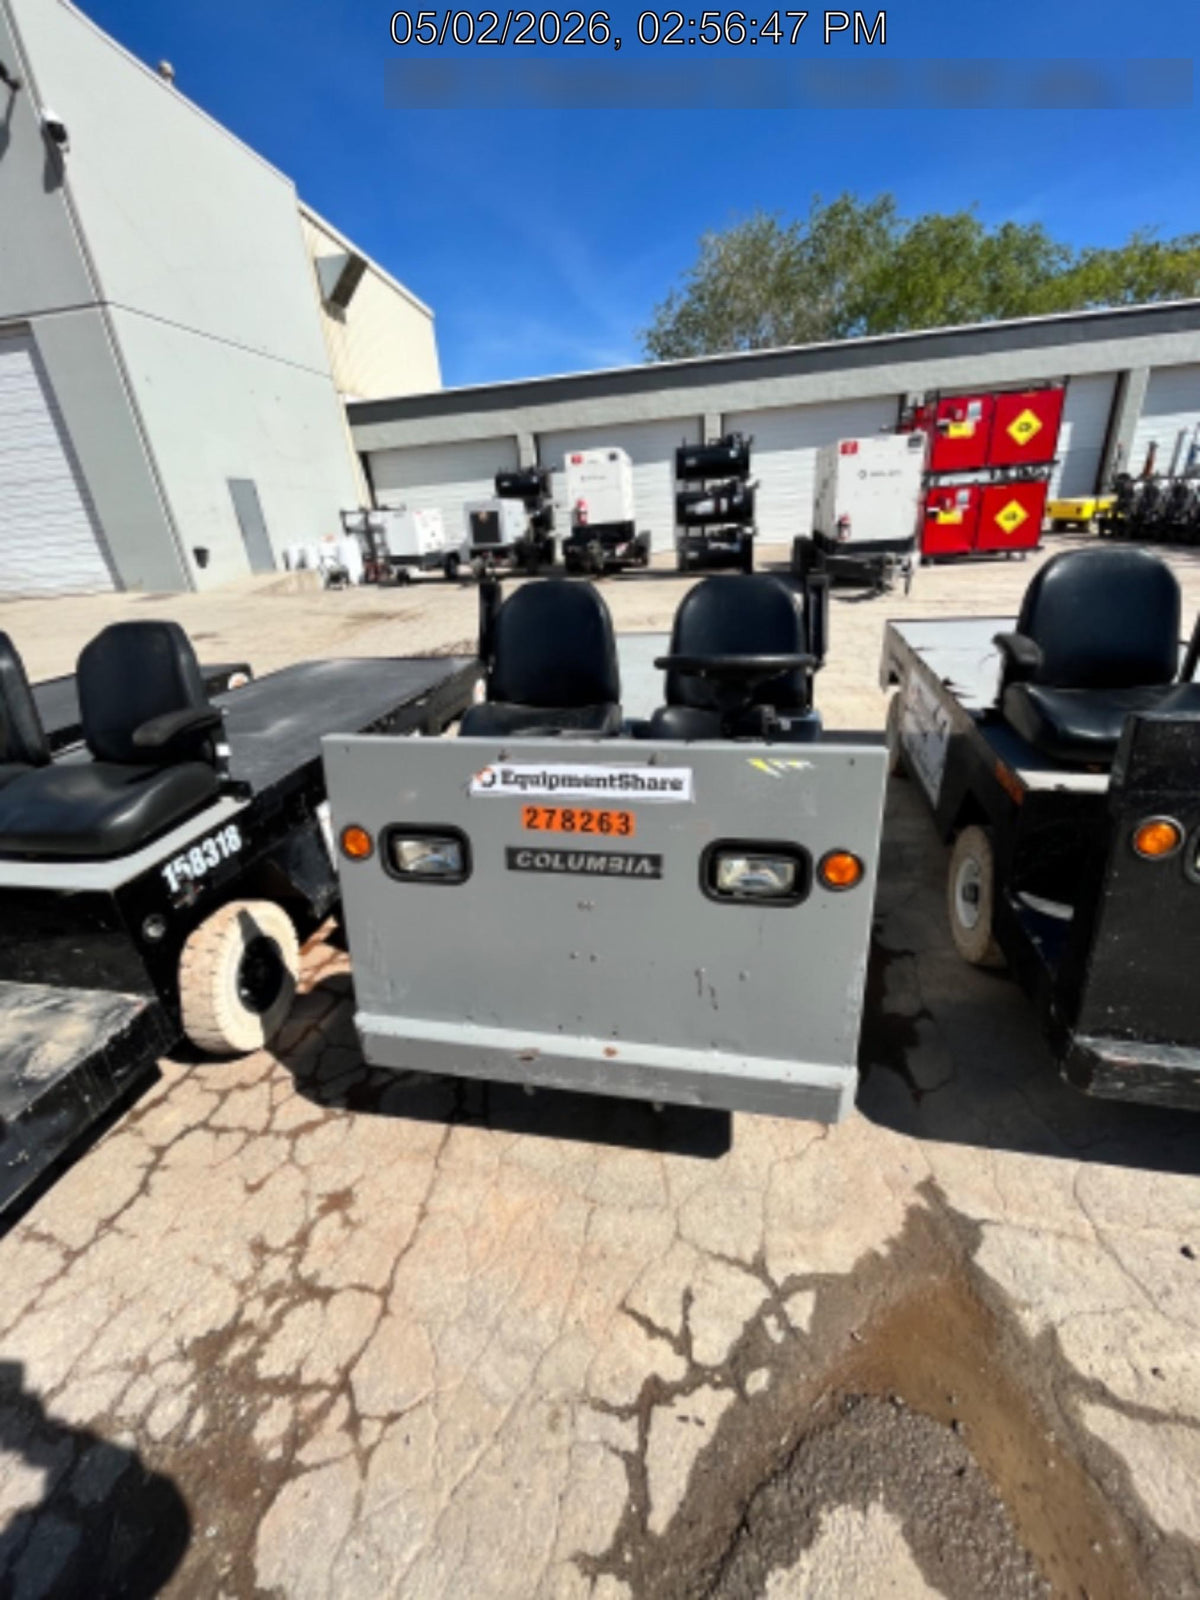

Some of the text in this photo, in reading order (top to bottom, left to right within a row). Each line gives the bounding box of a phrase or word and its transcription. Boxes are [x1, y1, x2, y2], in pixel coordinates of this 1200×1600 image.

[501, 770, 684, 792] EquipmentShare
[525, 807, 631, 835] 278263
[161, 824, 242, 892] 158318
[516, 851, 652, 875] COLUMBIA
